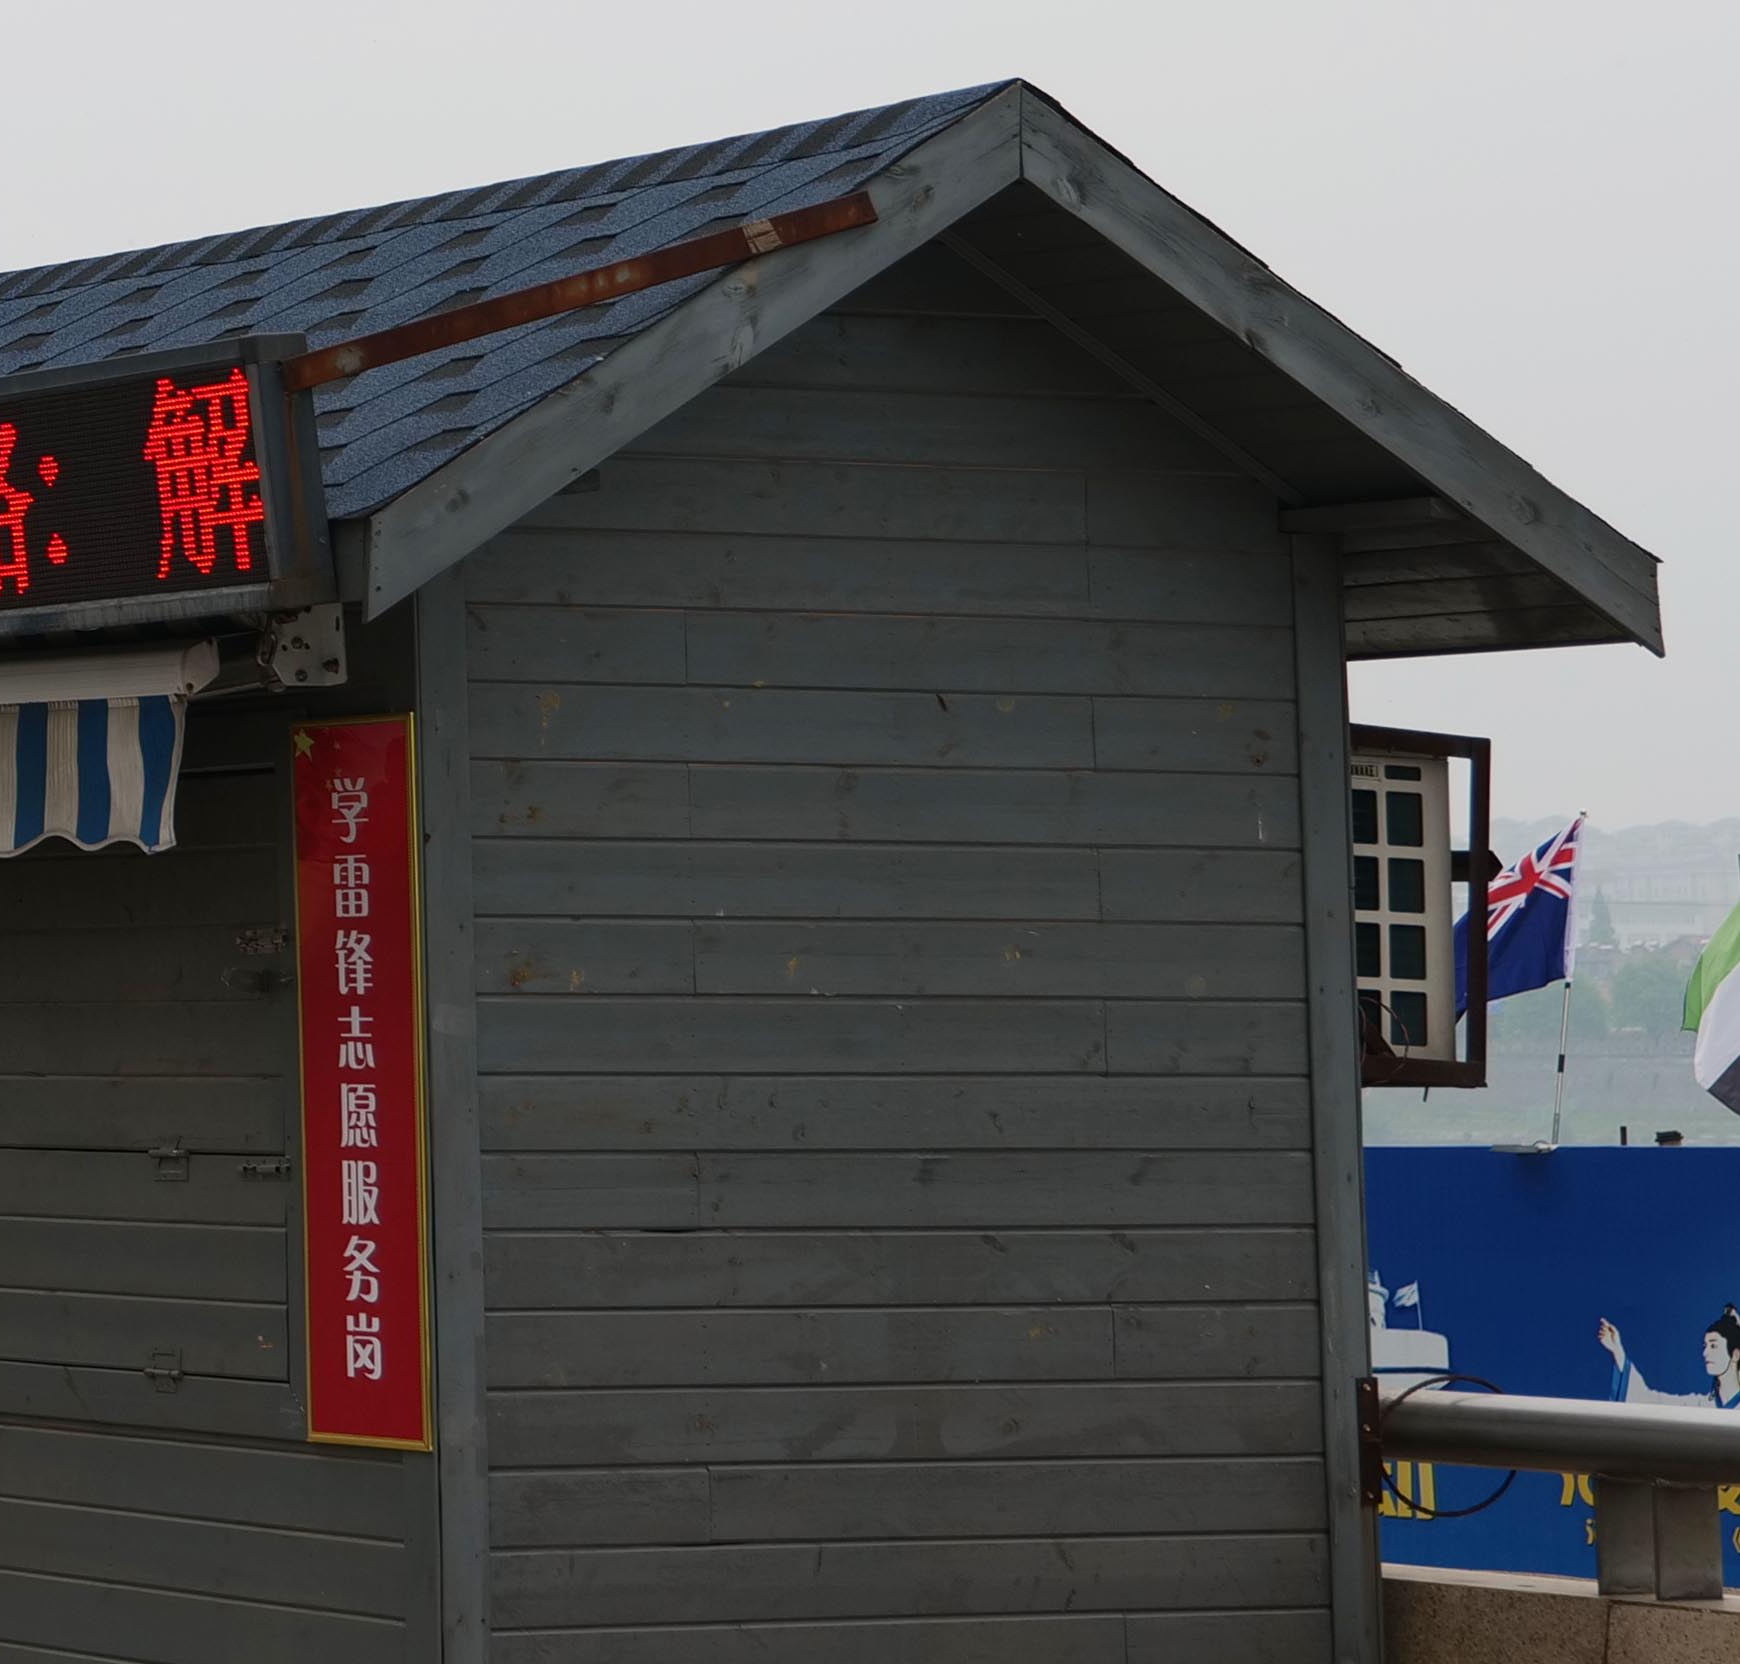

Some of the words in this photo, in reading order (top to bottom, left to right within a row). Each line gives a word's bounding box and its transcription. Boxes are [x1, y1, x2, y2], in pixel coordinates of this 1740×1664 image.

[329, 776, 382, 1381] 学雷锋志愿服务岗
